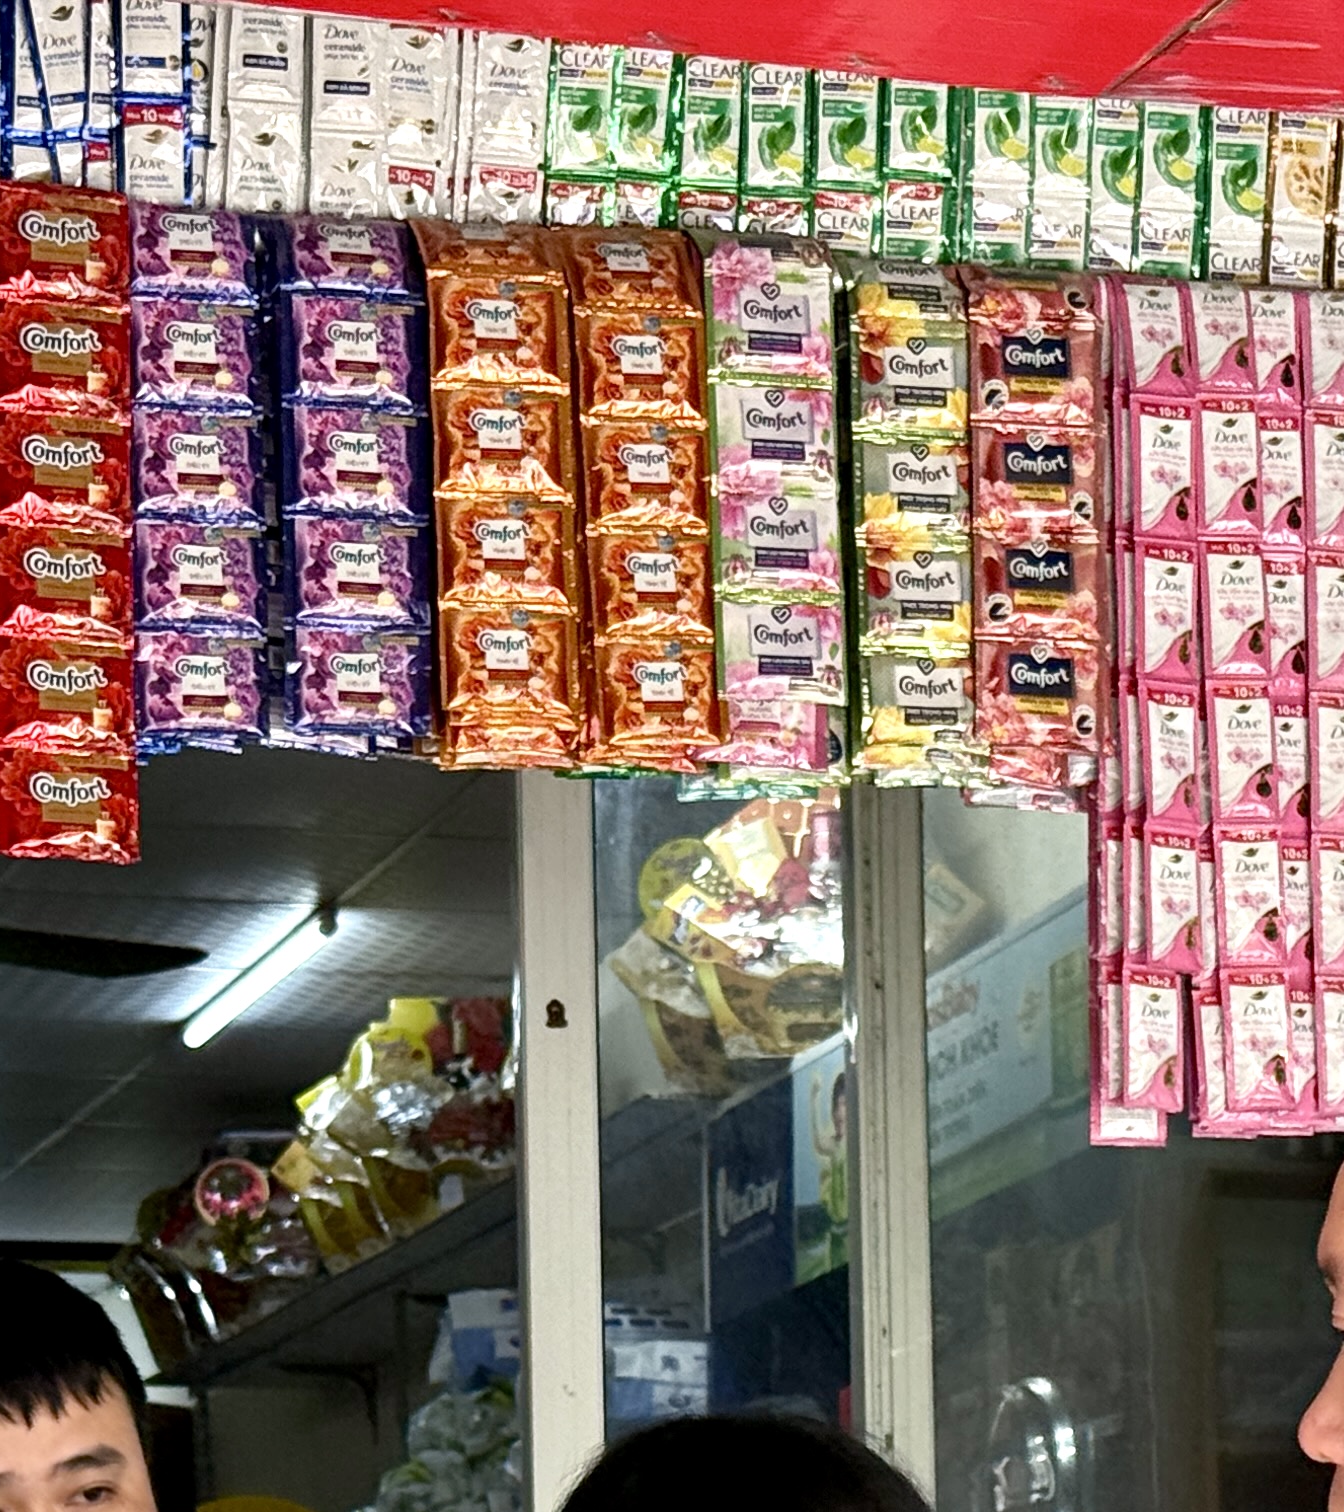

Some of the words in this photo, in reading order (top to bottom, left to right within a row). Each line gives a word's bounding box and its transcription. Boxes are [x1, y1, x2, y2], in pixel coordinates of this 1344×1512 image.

[1215, 107, 1266, 125] CLEAR
[19, 212, 99, 241] Comfort
[818, 213, 870, 232] CLEAR
[466, 300, 522, 323] Comfort
[743, 300, 803, 323] Comfort
[889, 354, 949, 377] Comfort
[1005, 344, 1066, 368] Comfort
[1215, 430, 1249, 446] Dove
[619, 447, 673, 469] Comfort
[172, 545, 227, 567] Comfort
[30, 773, 111, 804] Comfort
[1244, 1004, 1278, 1019] Dove
